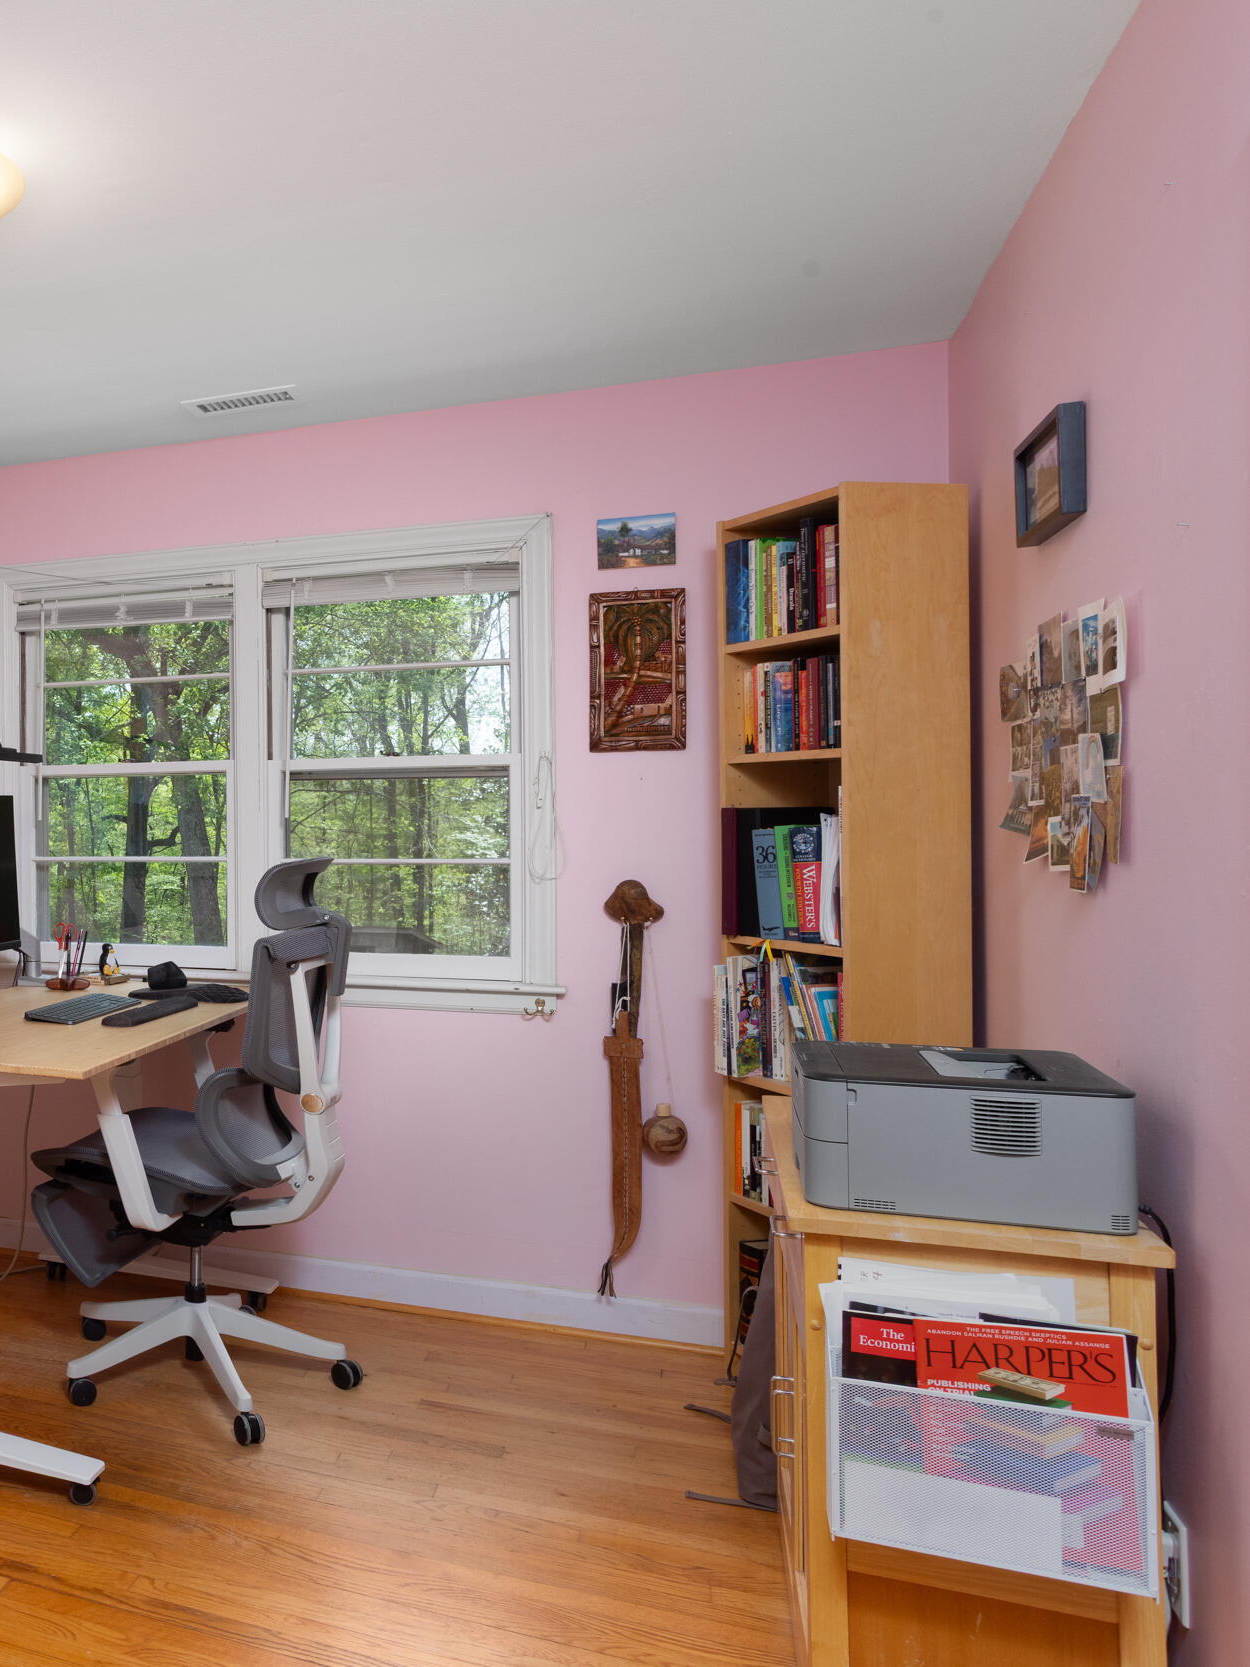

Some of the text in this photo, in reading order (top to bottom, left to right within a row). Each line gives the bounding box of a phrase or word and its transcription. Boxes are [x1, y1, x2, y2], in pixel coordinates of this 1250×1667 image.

[756, 845, 776, 864] 36
[794, 868, 802, 894] FOURTH
[802, 864, 816, 928] WEBSTER'S
[859, 1334, 915, 1353] Economi
[880, 1328, 905, 1340] The
[927, 1328, 962, 1336] ABANDON
[964, 1331, 993, 1339] SALMAN
[994, 1334, 1026, 1342] RUSHDIE
[1074, 1341, 1111, 1349] ASSANGE
[1001, 1329, 1030, 1337] SPEECH
[1031, 1331, 1067, 1340] SKEPTICS
[924, 1338, 1117, 1384] HARPER'S
[926, 1378, 992, 1392] PUBLISHING
